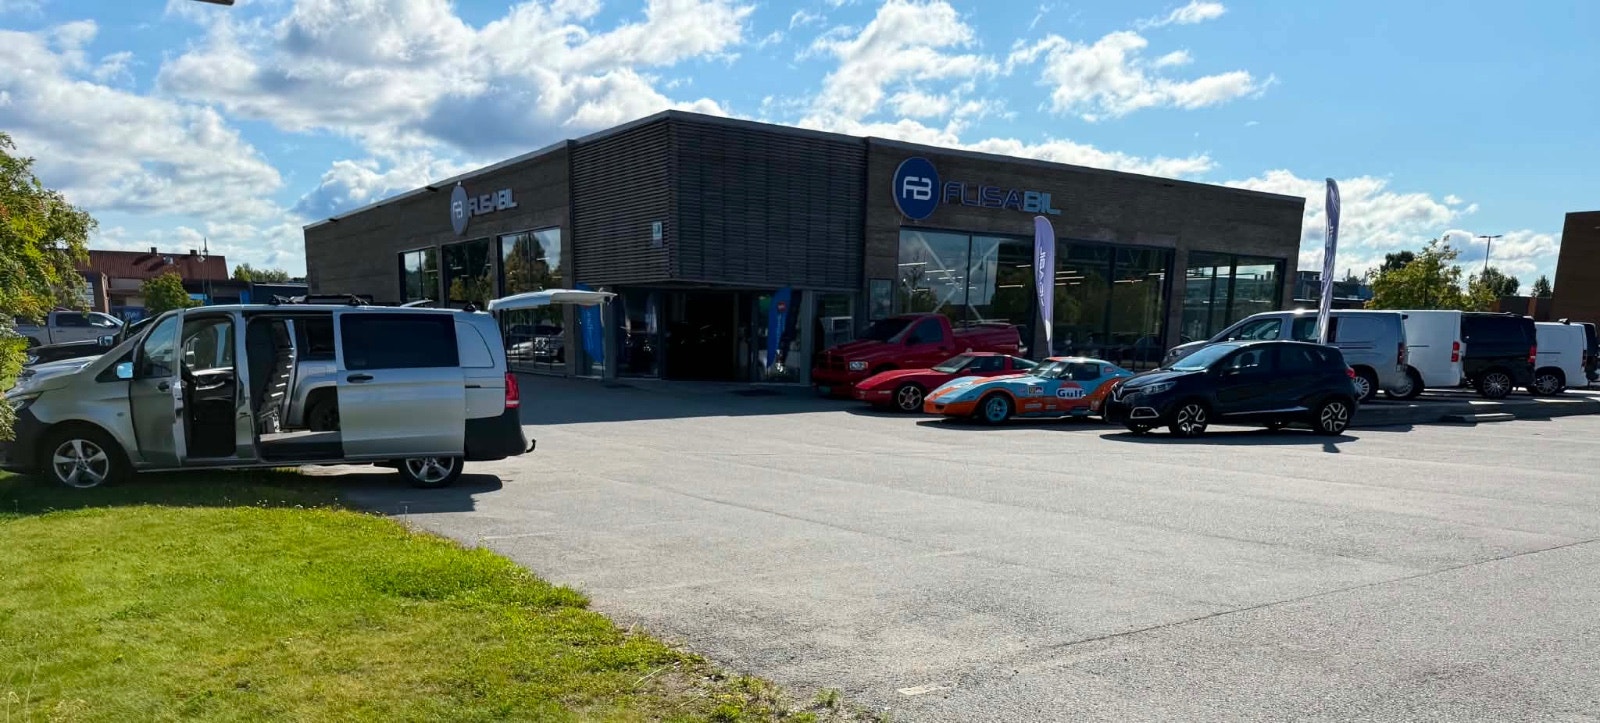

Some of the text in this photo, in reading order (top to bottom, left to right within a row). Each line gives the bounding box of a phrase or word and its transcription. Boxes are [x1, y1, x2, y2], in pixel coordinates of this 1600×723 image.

[468, 188, 518, 218] FLISABIL
[943, 181, 1062, 215] FLISABIL
[1057, 389, 1084, 398] Gulf
